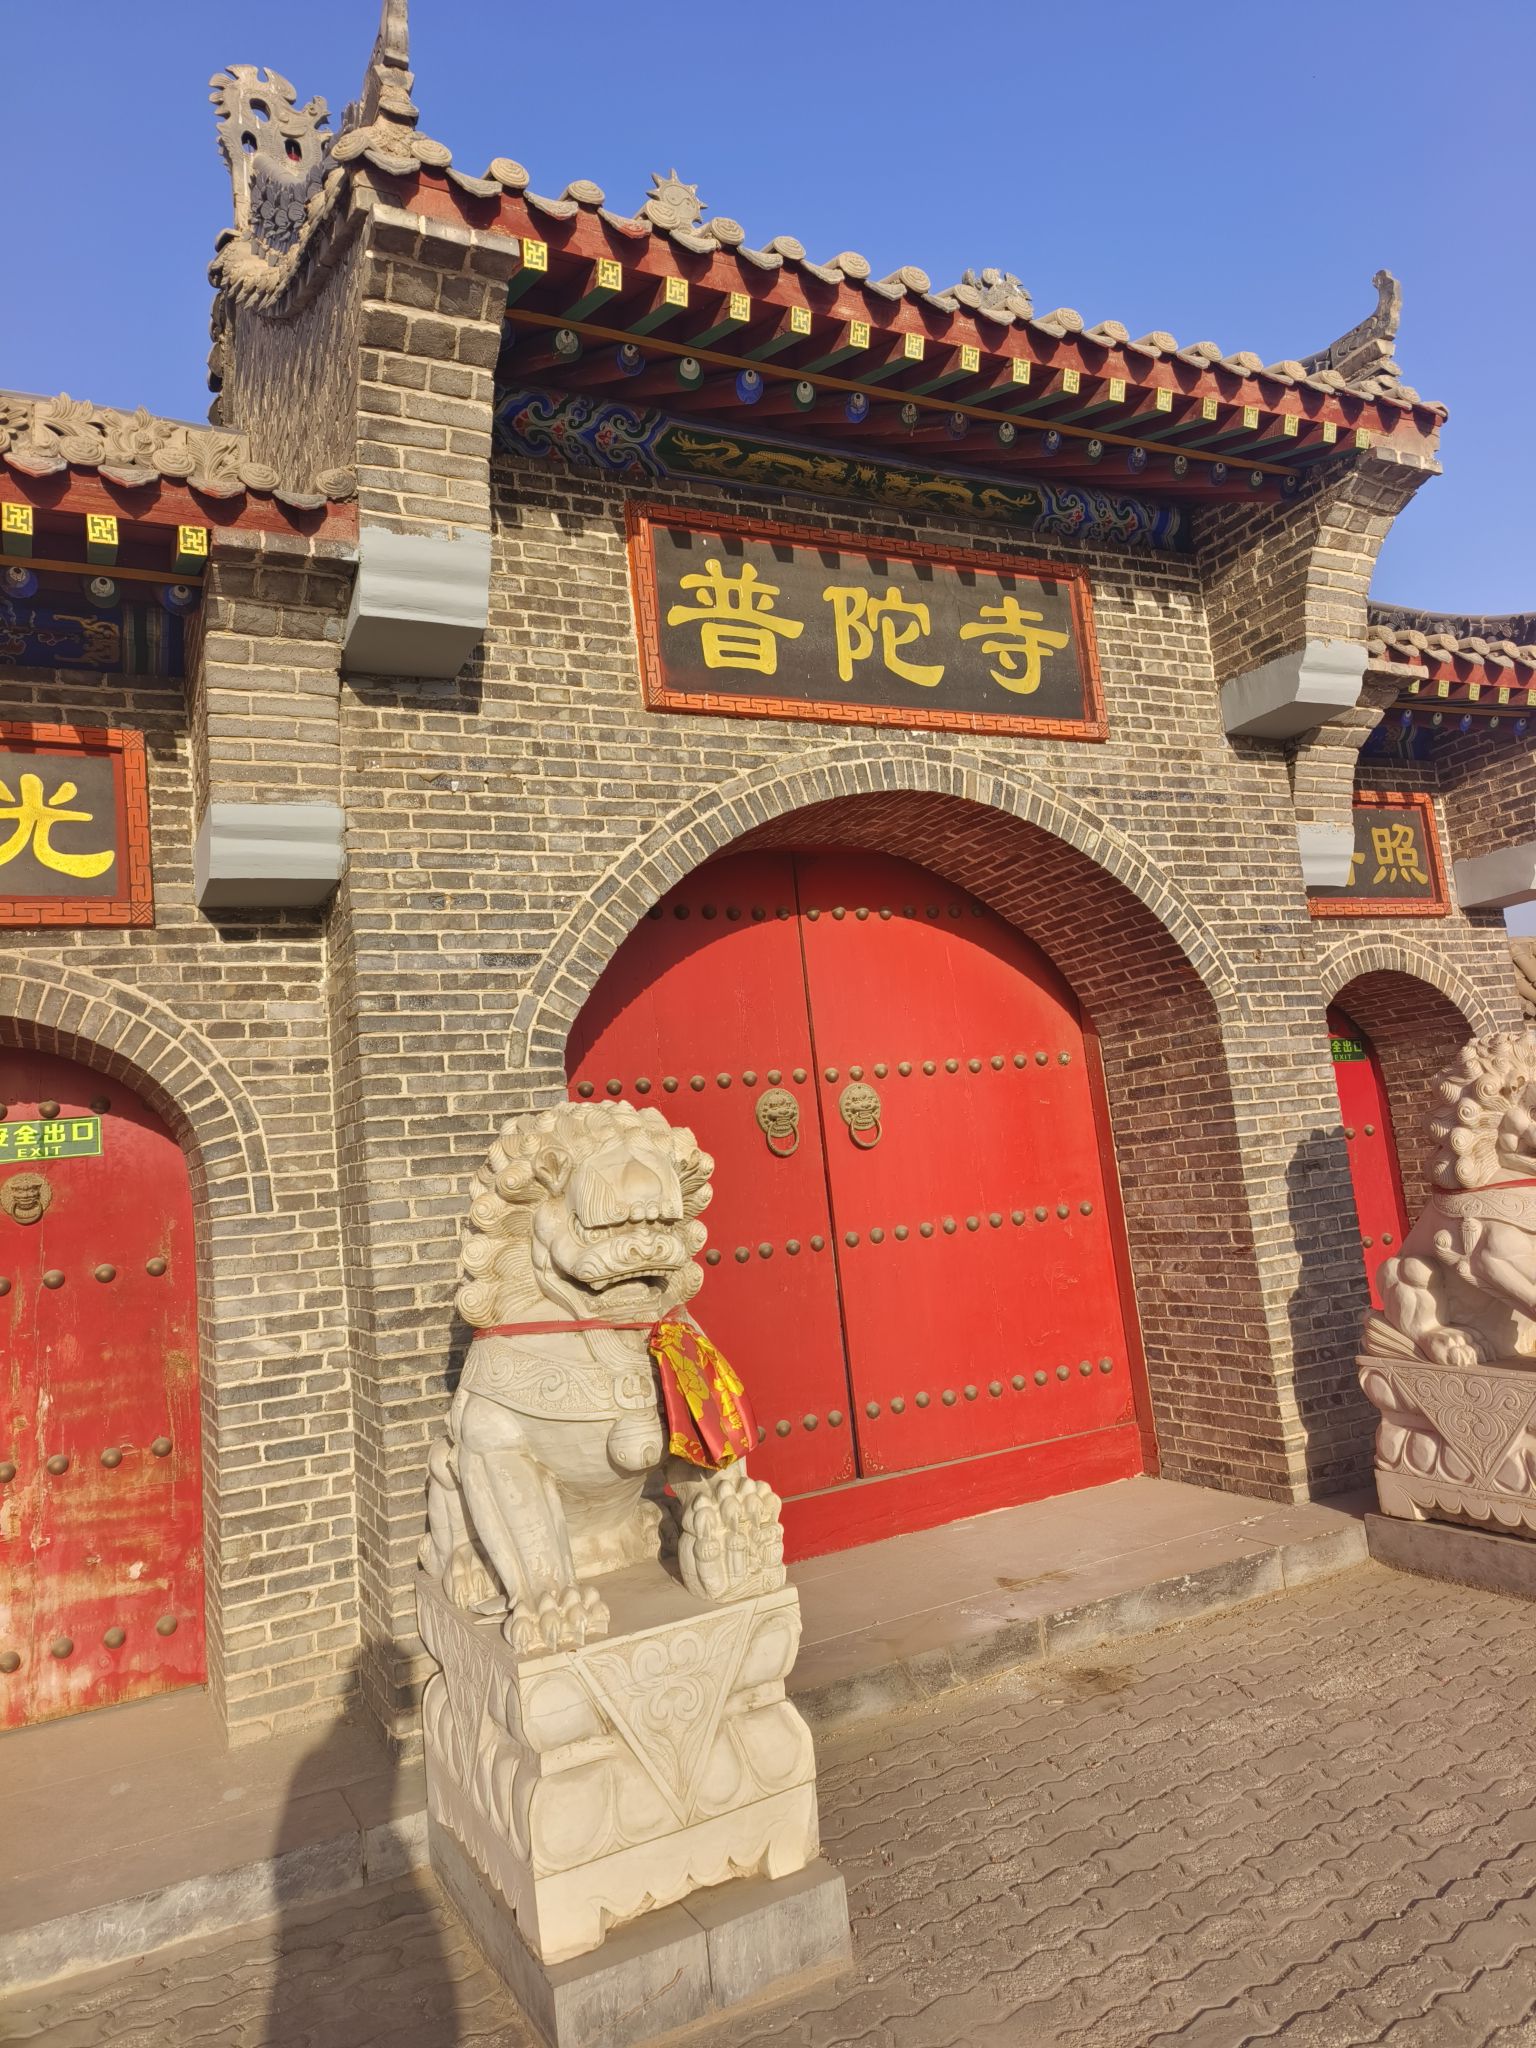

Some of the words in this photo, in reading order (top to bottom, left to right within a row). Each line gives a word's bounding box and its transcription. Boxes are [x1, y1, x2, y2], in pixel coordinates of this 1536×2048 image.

[667, 558, 1071, 695] 普陀寺
[0, 773, 116, 879] 光
[1346, 823, 1429, 886] 照
[17, 1145, 63, 1158] EXIT
